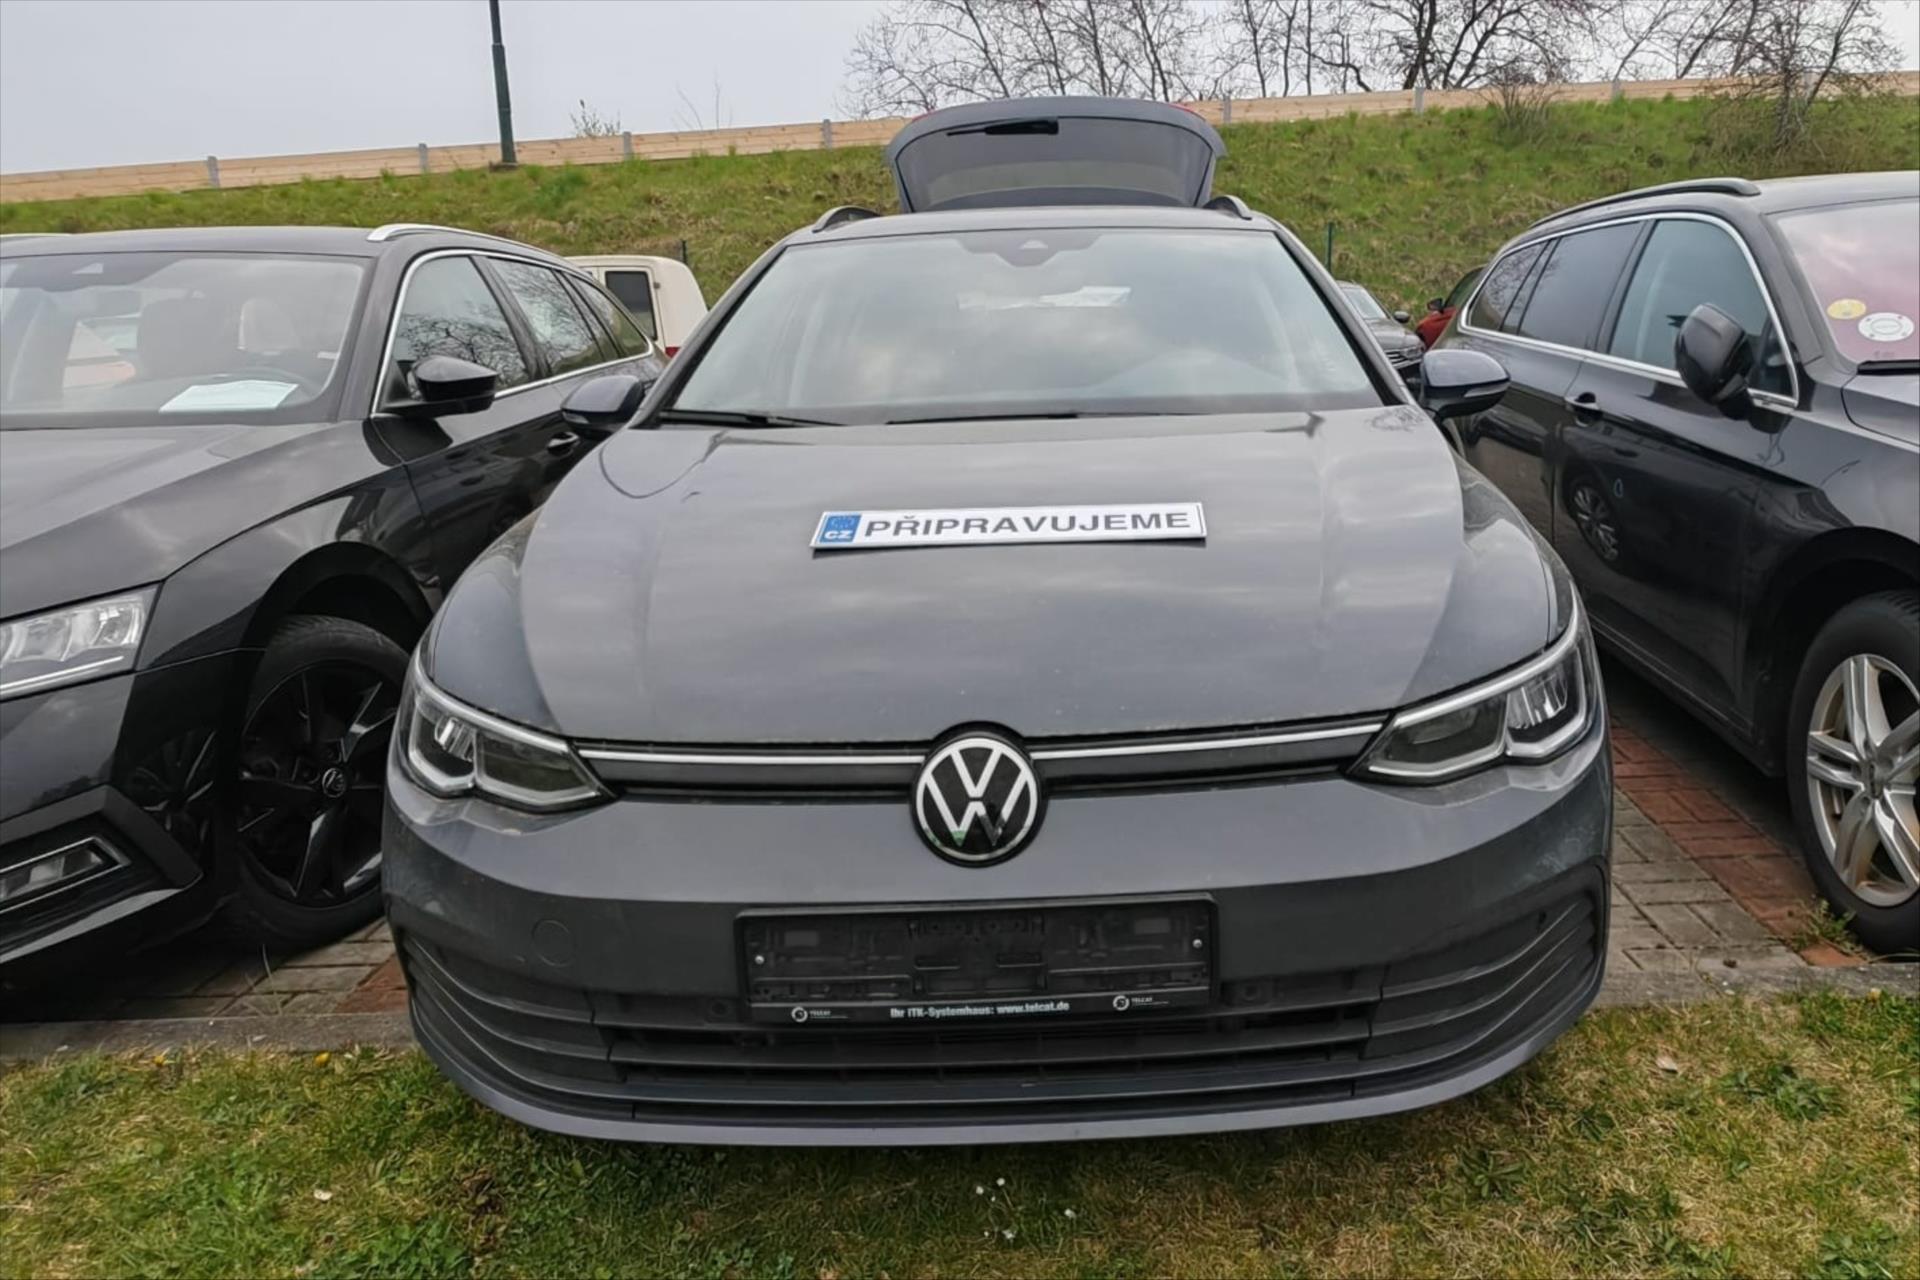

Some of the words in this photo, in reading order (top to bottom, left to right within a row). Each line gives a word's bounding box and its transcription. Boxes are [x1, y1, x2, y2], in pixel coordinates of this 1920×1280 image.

[865, 512, 1190, 537] PŘIPRAVUJEME
[824, 530, 853, 539] CZ
[890, 1007, 904, 1018] Ihr
